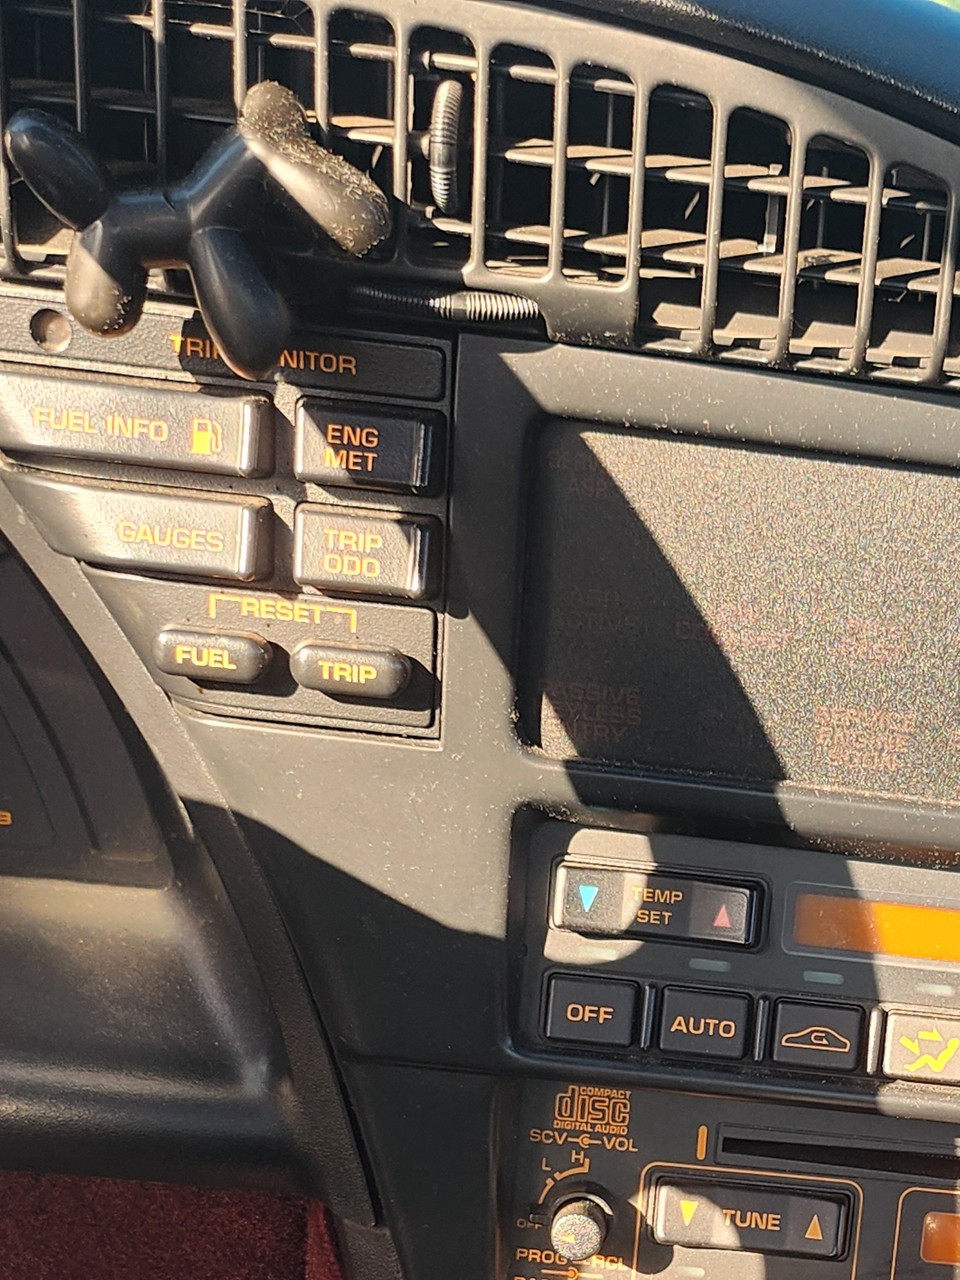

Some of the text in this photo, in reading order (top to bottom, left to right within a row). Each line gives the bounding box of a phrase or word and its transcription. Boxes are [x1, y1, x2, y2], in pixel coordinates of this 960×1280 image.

[279, 350, 358, 376] NITOR
[33, 407, 169, 442] FUEL INFO
[326, 424, 379, 448] ENG
[324, 448, 379, 472] MET
[117, 520, 225, 552] GAUGES
[323, 527, 384, 553] TRIP
[323, 553, 381, 578] ODO
[240, 598, 324, 624] RESET
[175, 643, 238, 670] FUEL
[318, 660, 378, 684] TRIP
[631, 886, 684, 905] TEMP
[636, 908, 673, 926] SET
[566, 1004, 614, 1024] OFF
[670, 1017, 736, 1039] AUTO
[580, 1086, 632, 1100] COMPACT
[553, 1119, 628, 1135] DIGITAL AUDIO
[529, 1128, 639, 1152] SCV VOL
[541, 1157, 552, 1171] L
[571, 1150, 585, 1164] H
[722, 1208, 783, 1231] TUNE
[516, 1248, 568, 1265] PROG
